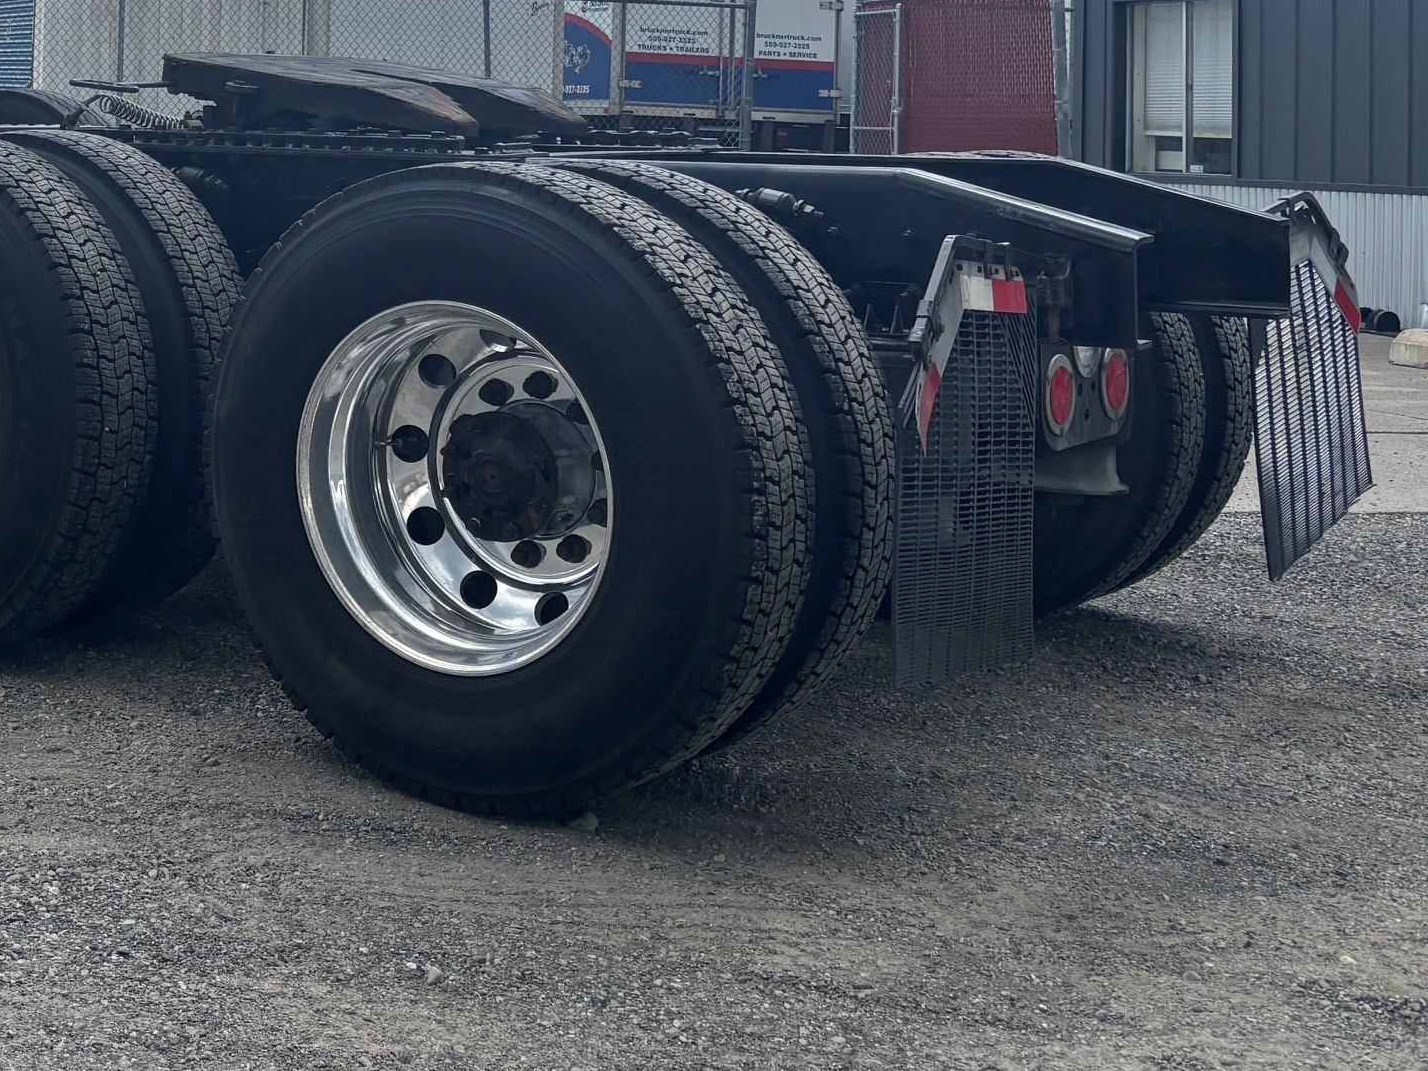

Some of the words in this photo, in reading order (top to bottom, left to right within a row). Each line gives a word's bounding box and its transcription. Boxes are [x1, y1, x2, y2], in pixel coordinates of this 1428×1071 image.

[756, 32, 822, 42] brucknertruck.com
[637, 44, 667, 52] TRUCKS
[675, 46, 710, 54] TRAILERS
[764, 41, 810, 49] 509-927-2525
